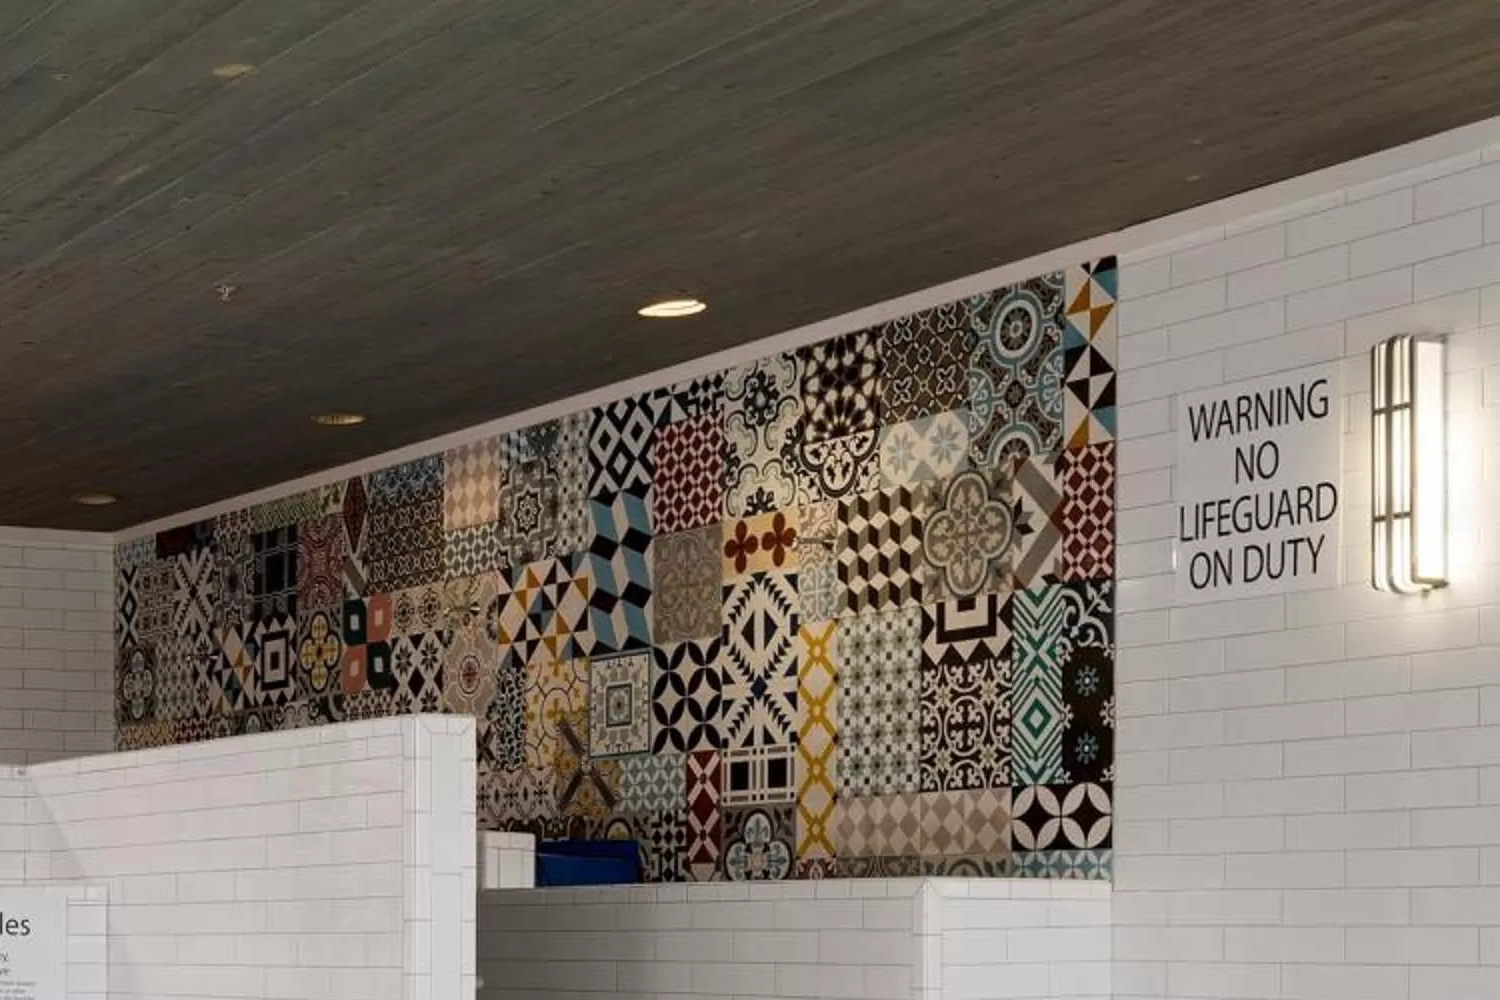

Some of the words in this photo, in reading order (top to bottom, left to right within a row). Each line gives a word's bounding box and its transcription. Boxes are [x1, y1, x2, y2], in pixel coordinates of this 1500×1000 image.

[1188, 379, 1329, 442] WARNING
[1235, 440, 1279, 484] NO
[1179, 482, 1338, 542] LIFEGUARD
[1190, 548, 1233, 590] ON
[1243, 534, 1325, 584] DUTY
